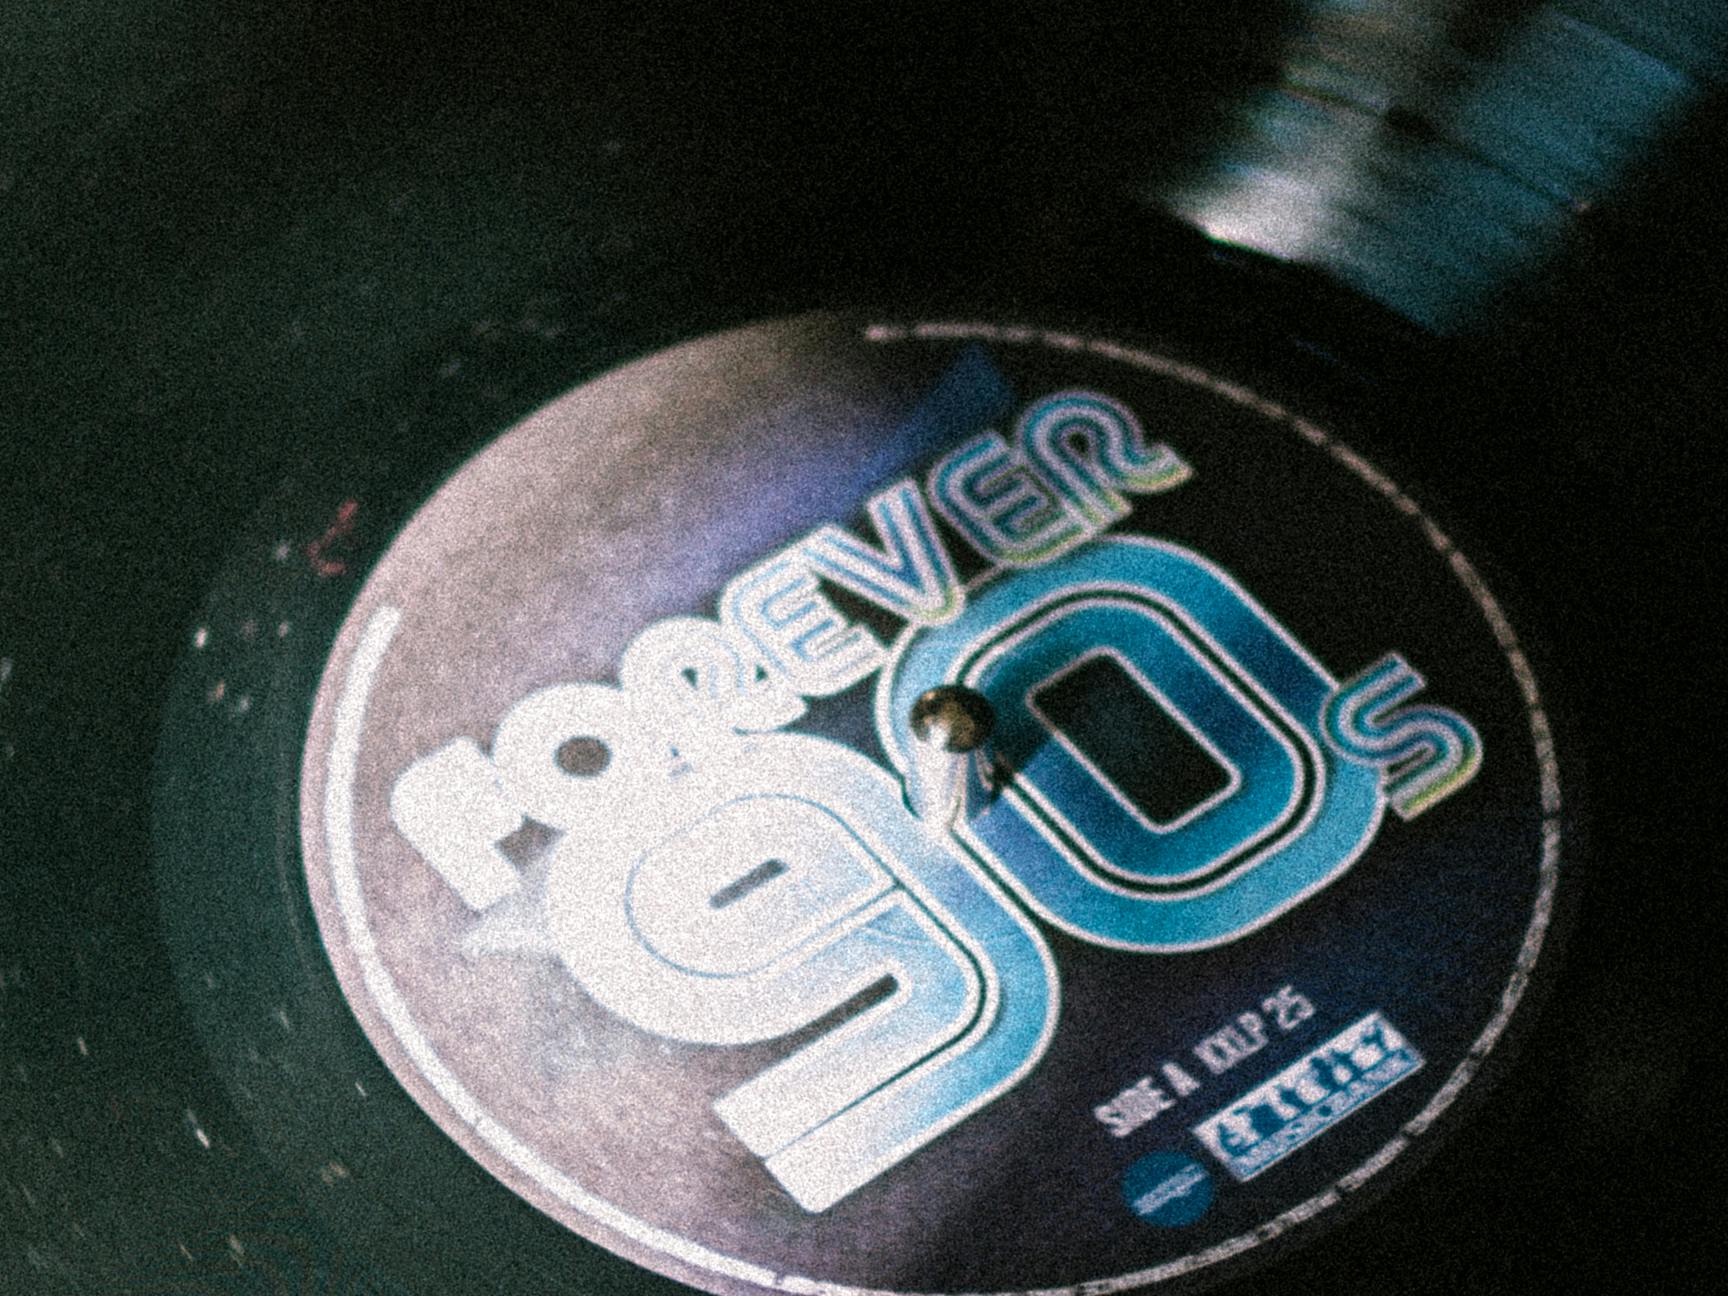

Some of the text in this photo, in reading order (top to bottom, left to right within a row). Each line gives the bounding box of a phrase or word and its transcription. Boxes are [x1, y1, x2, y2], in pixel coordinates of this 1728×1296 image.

[389, 390, 1194, 909] FOREVER
[1094, 1075, 1176, 1139] SIDE
[1162, 1061, 1201, 1097] A
[1261, 984, 1316, 1031] 25
